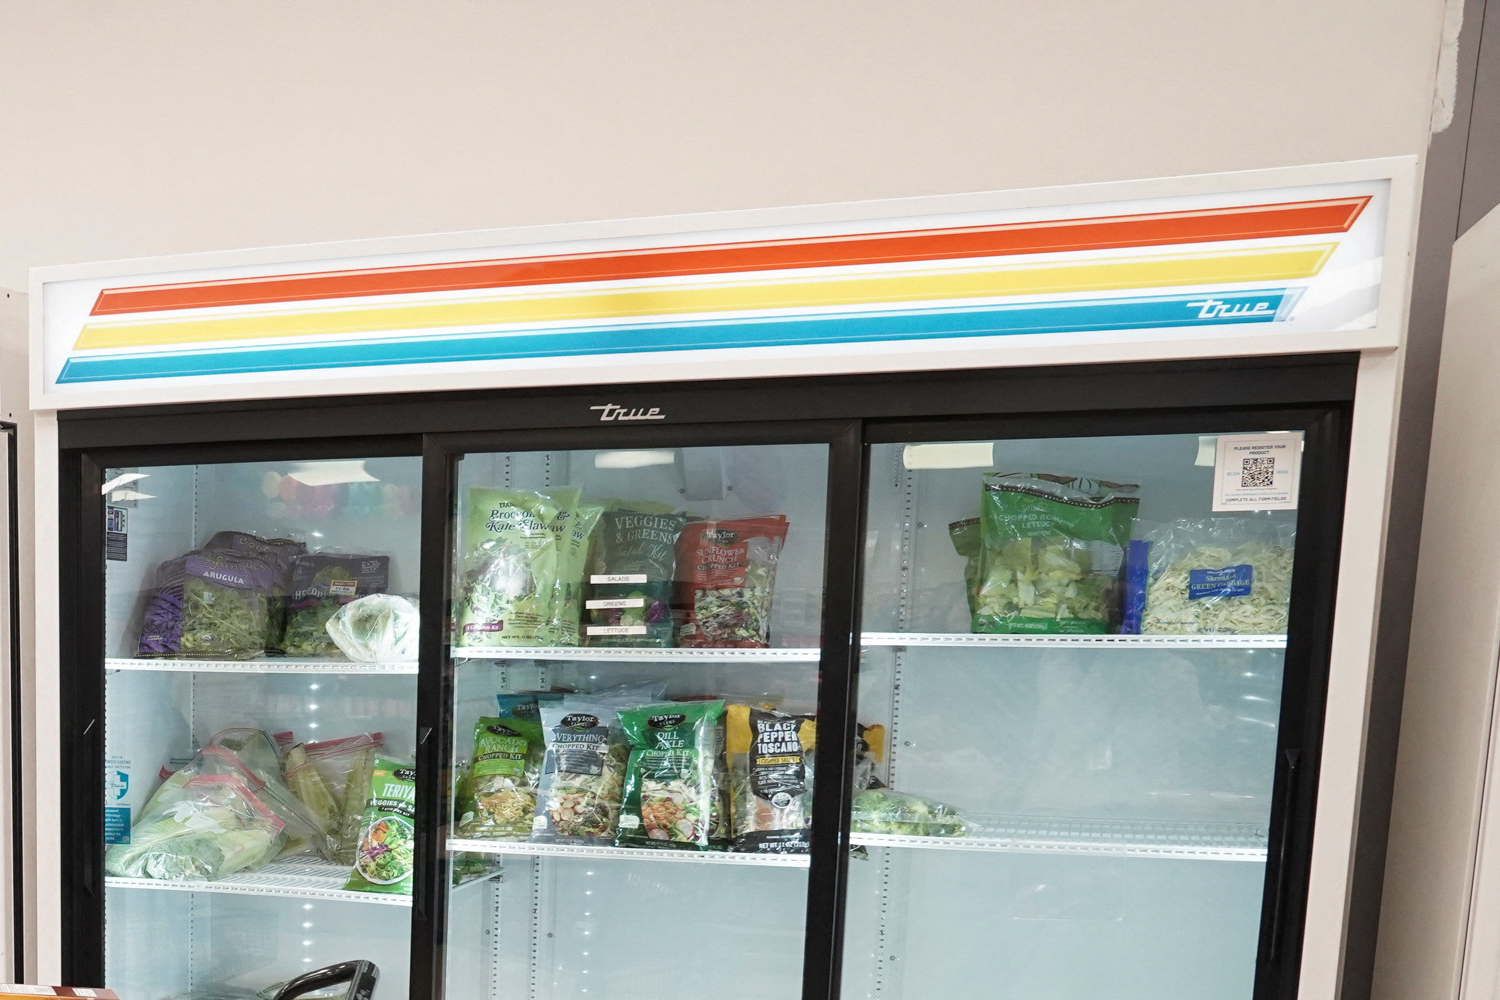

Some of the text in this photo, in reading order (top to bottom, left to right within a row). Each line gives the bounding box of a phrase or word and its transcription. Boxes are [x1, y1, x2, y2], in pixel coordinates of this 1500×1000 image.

[1186, 299, 1276, 318] true
[590, 404, 666, 420] true
[557, 511, 570, 520] &
[486, 522, 516, 532] Kale
[615, 515, 677, 531] VEGGIES
[616, 529, 672, 544] & GREENS
[648, 543, 668, 561] Kit
[696, 546, 745, 556] SUNFLOWER
[702, 555, 737, 563] CRUNCH
[203, 571, 244, 584] ARUGULA
[1206, 574, 1237, 582] Shredded
[757, 723, 796, 732] BLACK
[555, 732, 605, 742] VERYTHING
[658, 731, 679, 740] DILL
[758, 731, 798, 742] PEPPER
[481, 737, 527, 746] AVOCADO
[486, 744, 519, 753] RANCH
[646, 749, 674, 757] CHOPPD
[758, 742, 799, 754] TOSCANO
[400, 768, 415, 776] Tay
